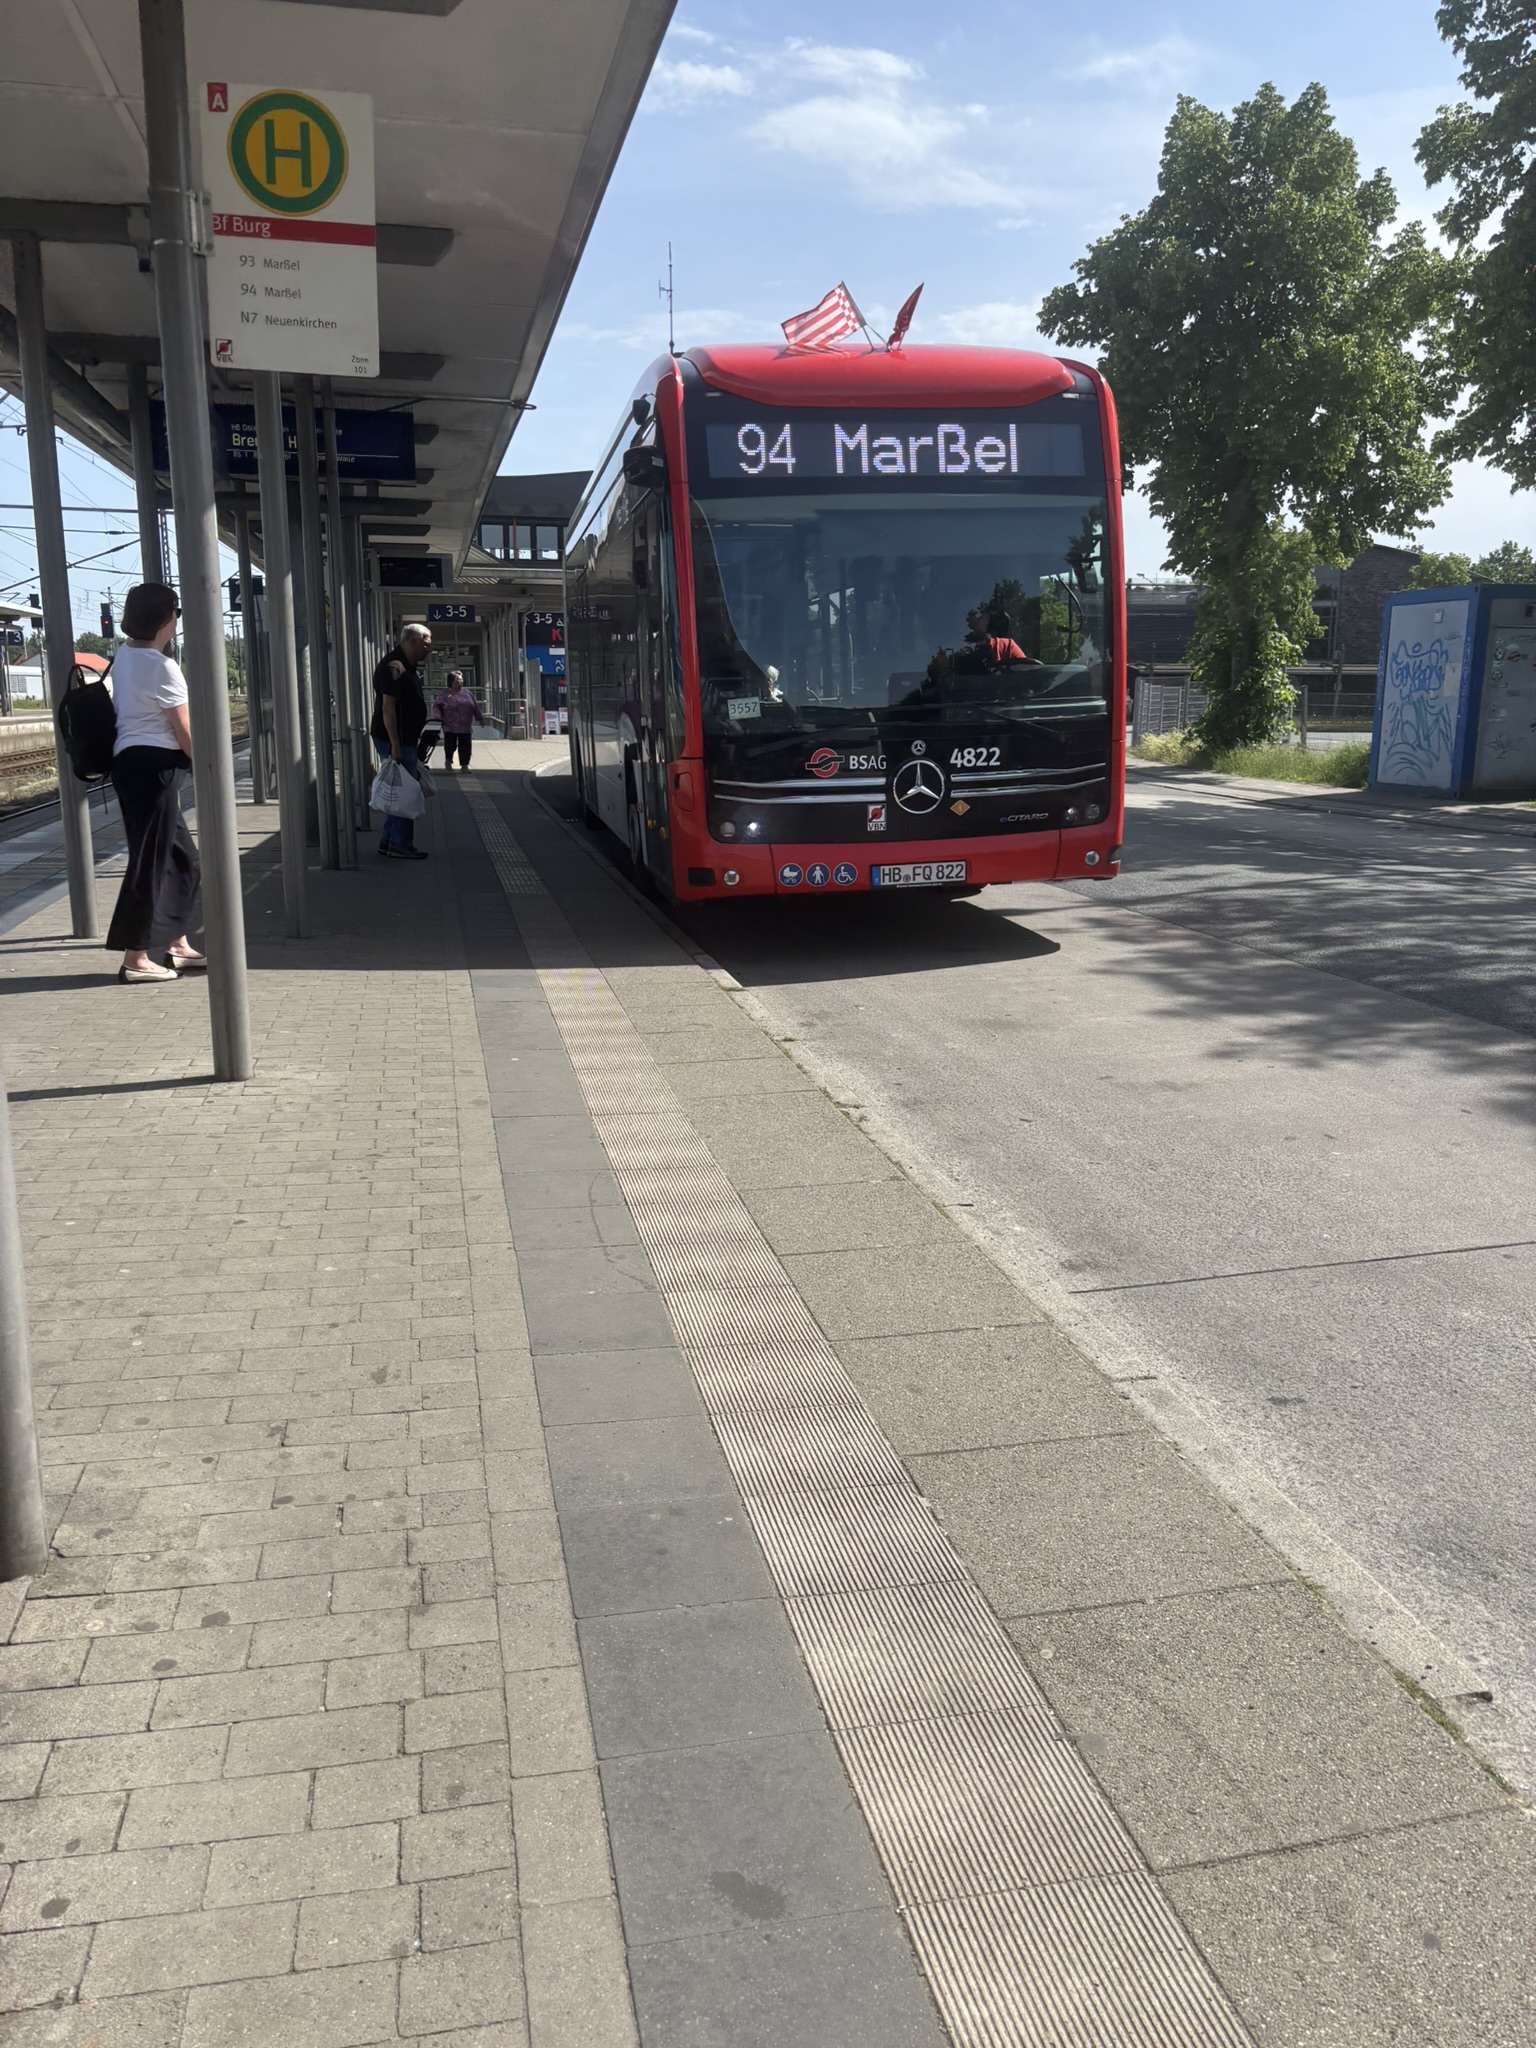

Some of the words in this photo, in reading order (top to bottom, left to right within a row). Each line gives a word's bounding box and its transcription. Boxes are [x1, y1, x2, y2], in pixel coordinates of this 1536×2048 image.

[213, 93, 225, 110] A
[265, 119, 312, 188] H
[233, 217, 271, 237] Burg
[239, 255, 256, 267] 93
[240, 283, 257, 296] 94
[240, 311, 258, 324] N7
[265, 314, 337, 329] Neuenkirchen
[351, 356, 369, 364] Zone
[354, 366, 367, 374] 101
[737, 424, 796, 474] 94
[446, 606, 466, 617] 3-5
[533, 613, 552, 625] 3-5
[14, 632, 21, 642] 3
[730, 702, 757, 714] 3557
[849, 755, 887, 770] BSAG
[950, 747, 1001, 768] 4822
[868, 823, 886, 831] VBN
[881, 865, 902, 885] HB
[912, 864, 933, 881] FQ
[936, 862, 965, 880] 822
